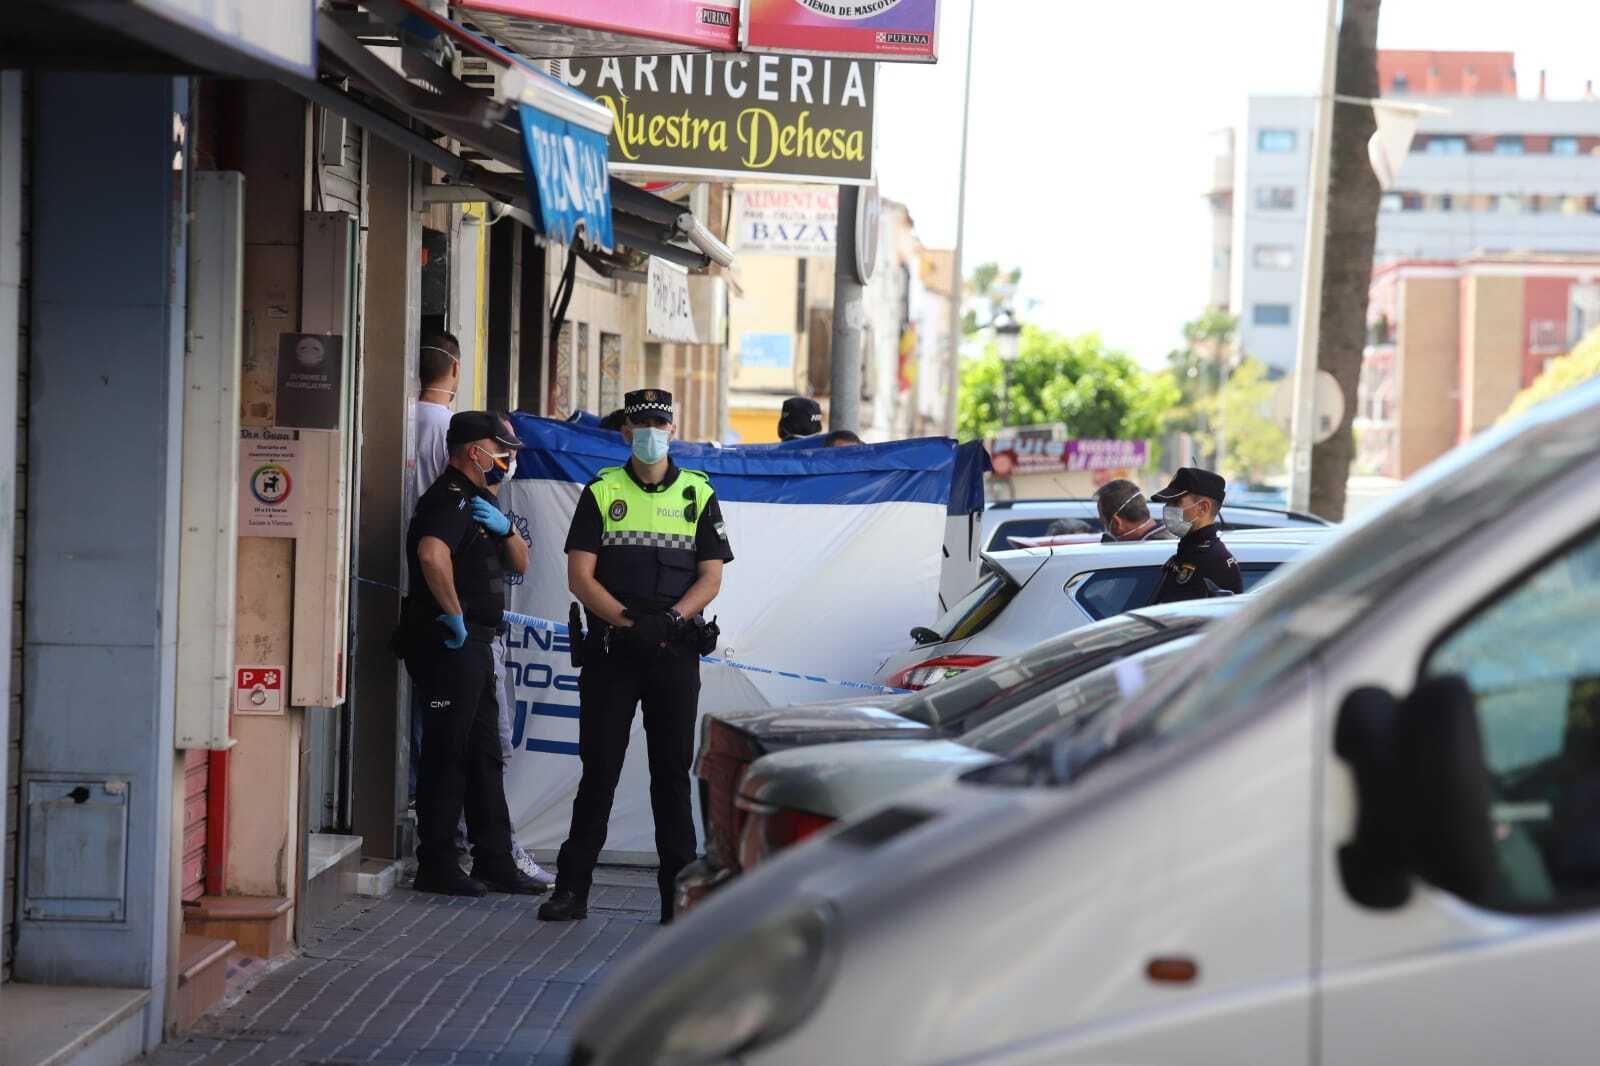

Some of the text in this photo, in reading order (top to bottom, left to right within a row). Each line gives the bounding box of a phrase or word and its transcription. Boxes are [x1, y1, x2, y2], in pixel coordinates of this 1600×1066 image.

[702, 9, 731, 25] PURINA
[839, 6, 852, 16] DE
[887, 34, 927, 44] PURINA
[562, 53, 867, 108] CARNICERIA
[594, 94, 728, 160] Nuestra
[737, 108, 865, 168] Dehesa
[752, 223, 836, 241] BAZA
[656, 507, 687, 520] POLICI
[242, 671, 254, 686] P
[430, 699, 451, 708] CNP
